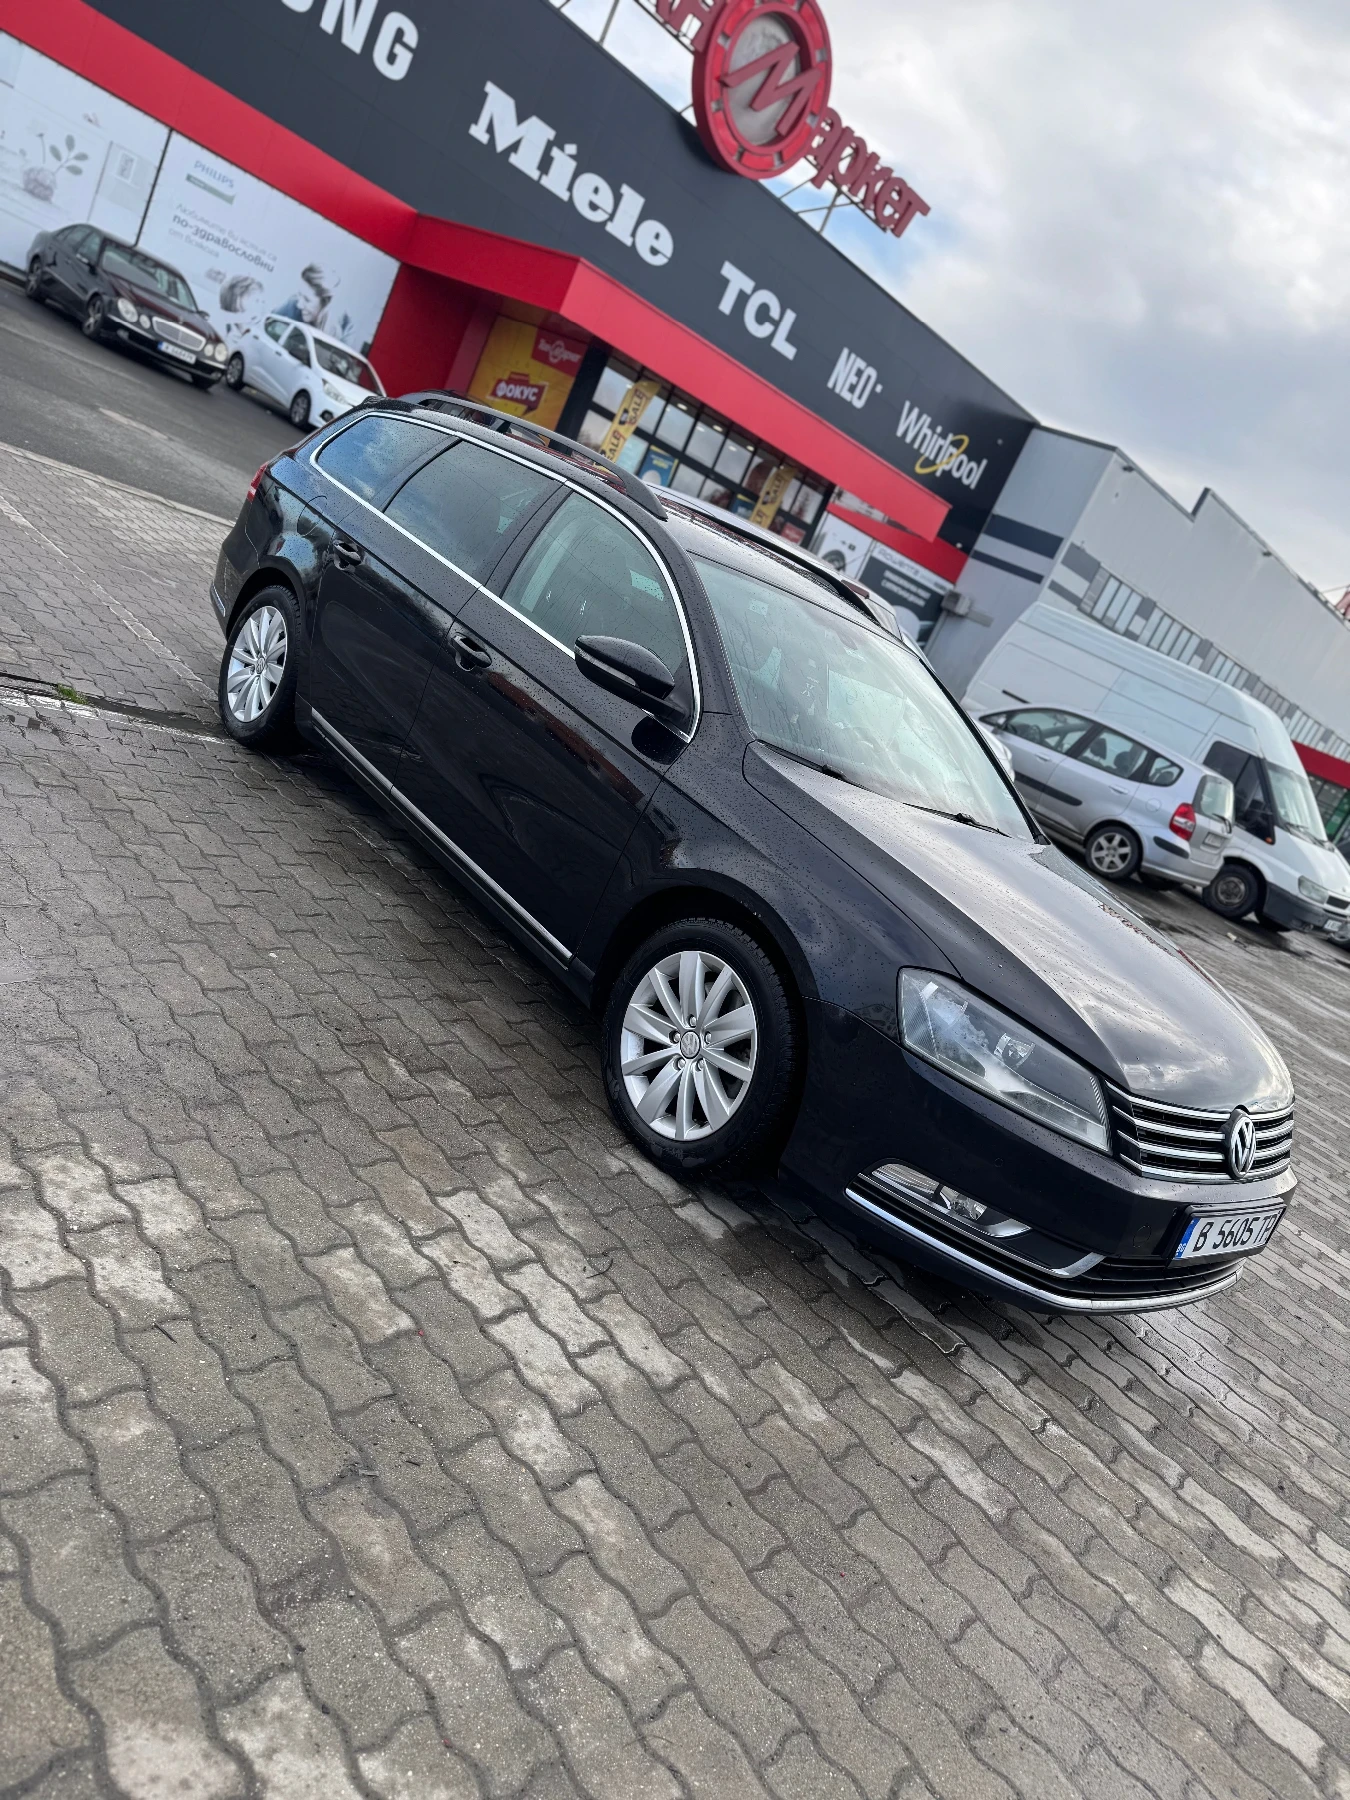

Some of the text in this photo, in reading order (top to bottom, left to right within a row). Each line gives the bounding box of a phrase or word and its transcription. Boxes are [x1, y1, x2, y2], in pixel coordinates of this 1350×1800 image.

[281, 0, 420, 81] NG
[193, 160, 235, 189] PHILIPS
[468, 81, 674, 267] Miele
[172, 214, 275, 273] по-здравословни
[718, 260, 797, 361] TCL
[496, 380, 539, 401] ФОКУС
[896, 400, 988, 490] Whirlpool
[1212, 1216, 1260, 1250] 5605
